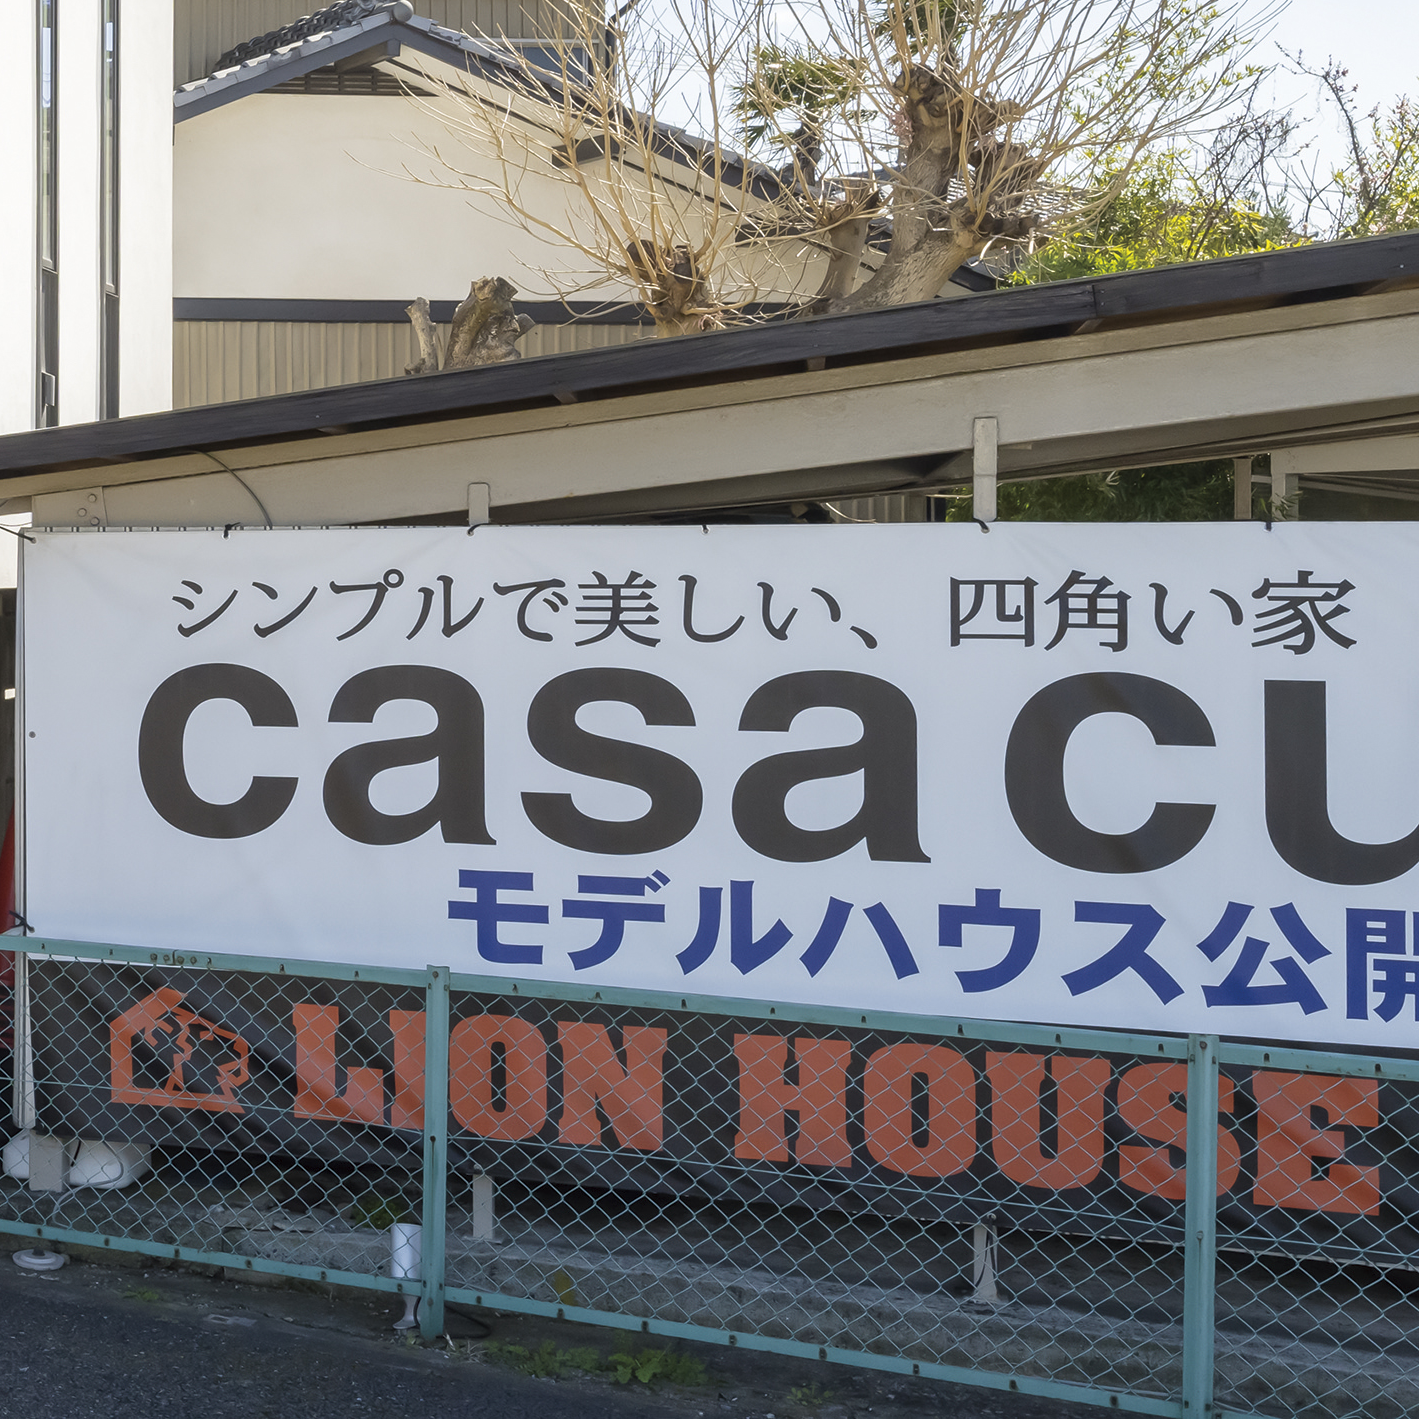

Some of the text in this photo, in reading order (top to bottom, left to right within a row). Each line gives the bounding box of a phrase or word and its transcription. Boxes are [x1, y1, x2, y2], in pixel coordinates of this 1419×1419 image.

[138, 662, 1419, 886] casa cu
[292, 1002, 1381, 1217] LION HOUSE
